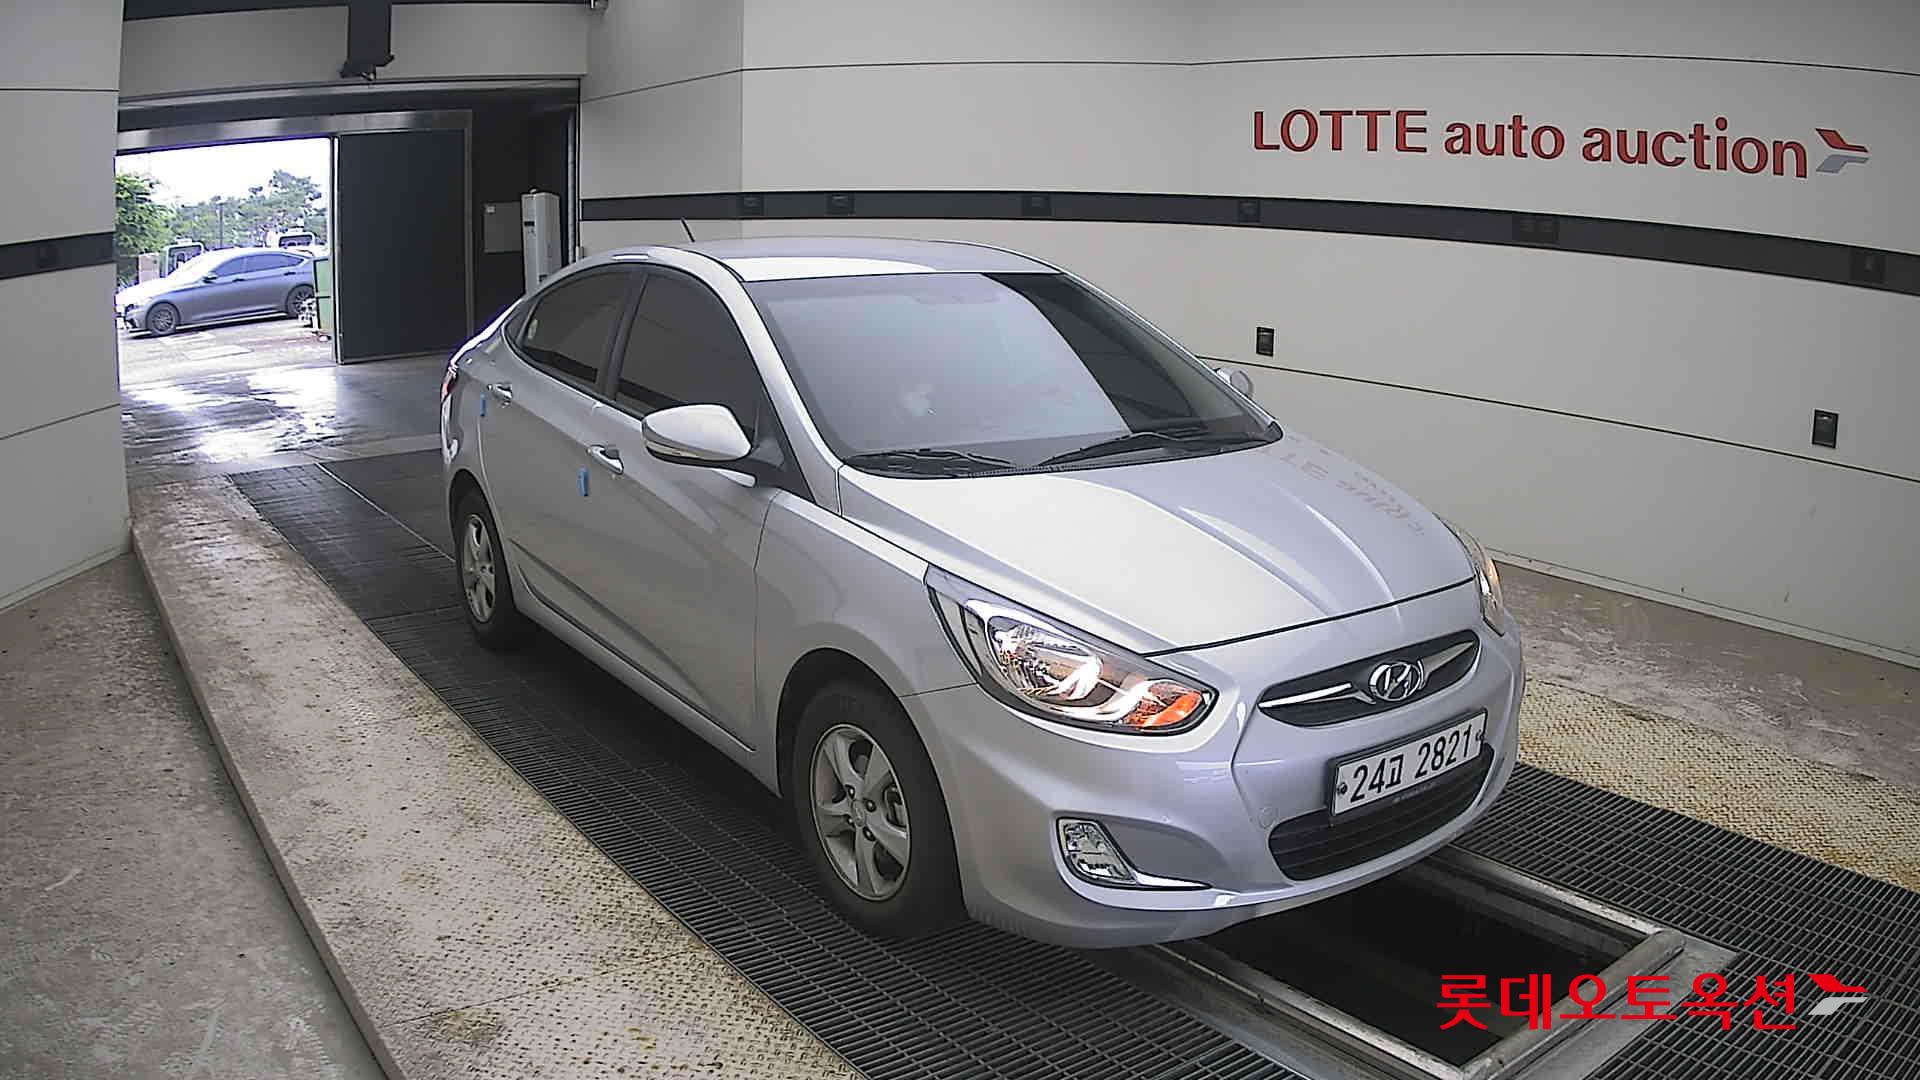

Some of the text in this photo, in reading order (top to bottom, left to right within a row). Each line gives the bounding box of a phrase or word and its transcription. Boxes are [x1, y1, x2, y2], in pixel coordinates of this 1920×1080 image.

[1254, 109, 1808, 179] LOTTE auto auction
[1350, 754, 1404, 803] 24고
[1415, 724, 1472, 779] 2821
